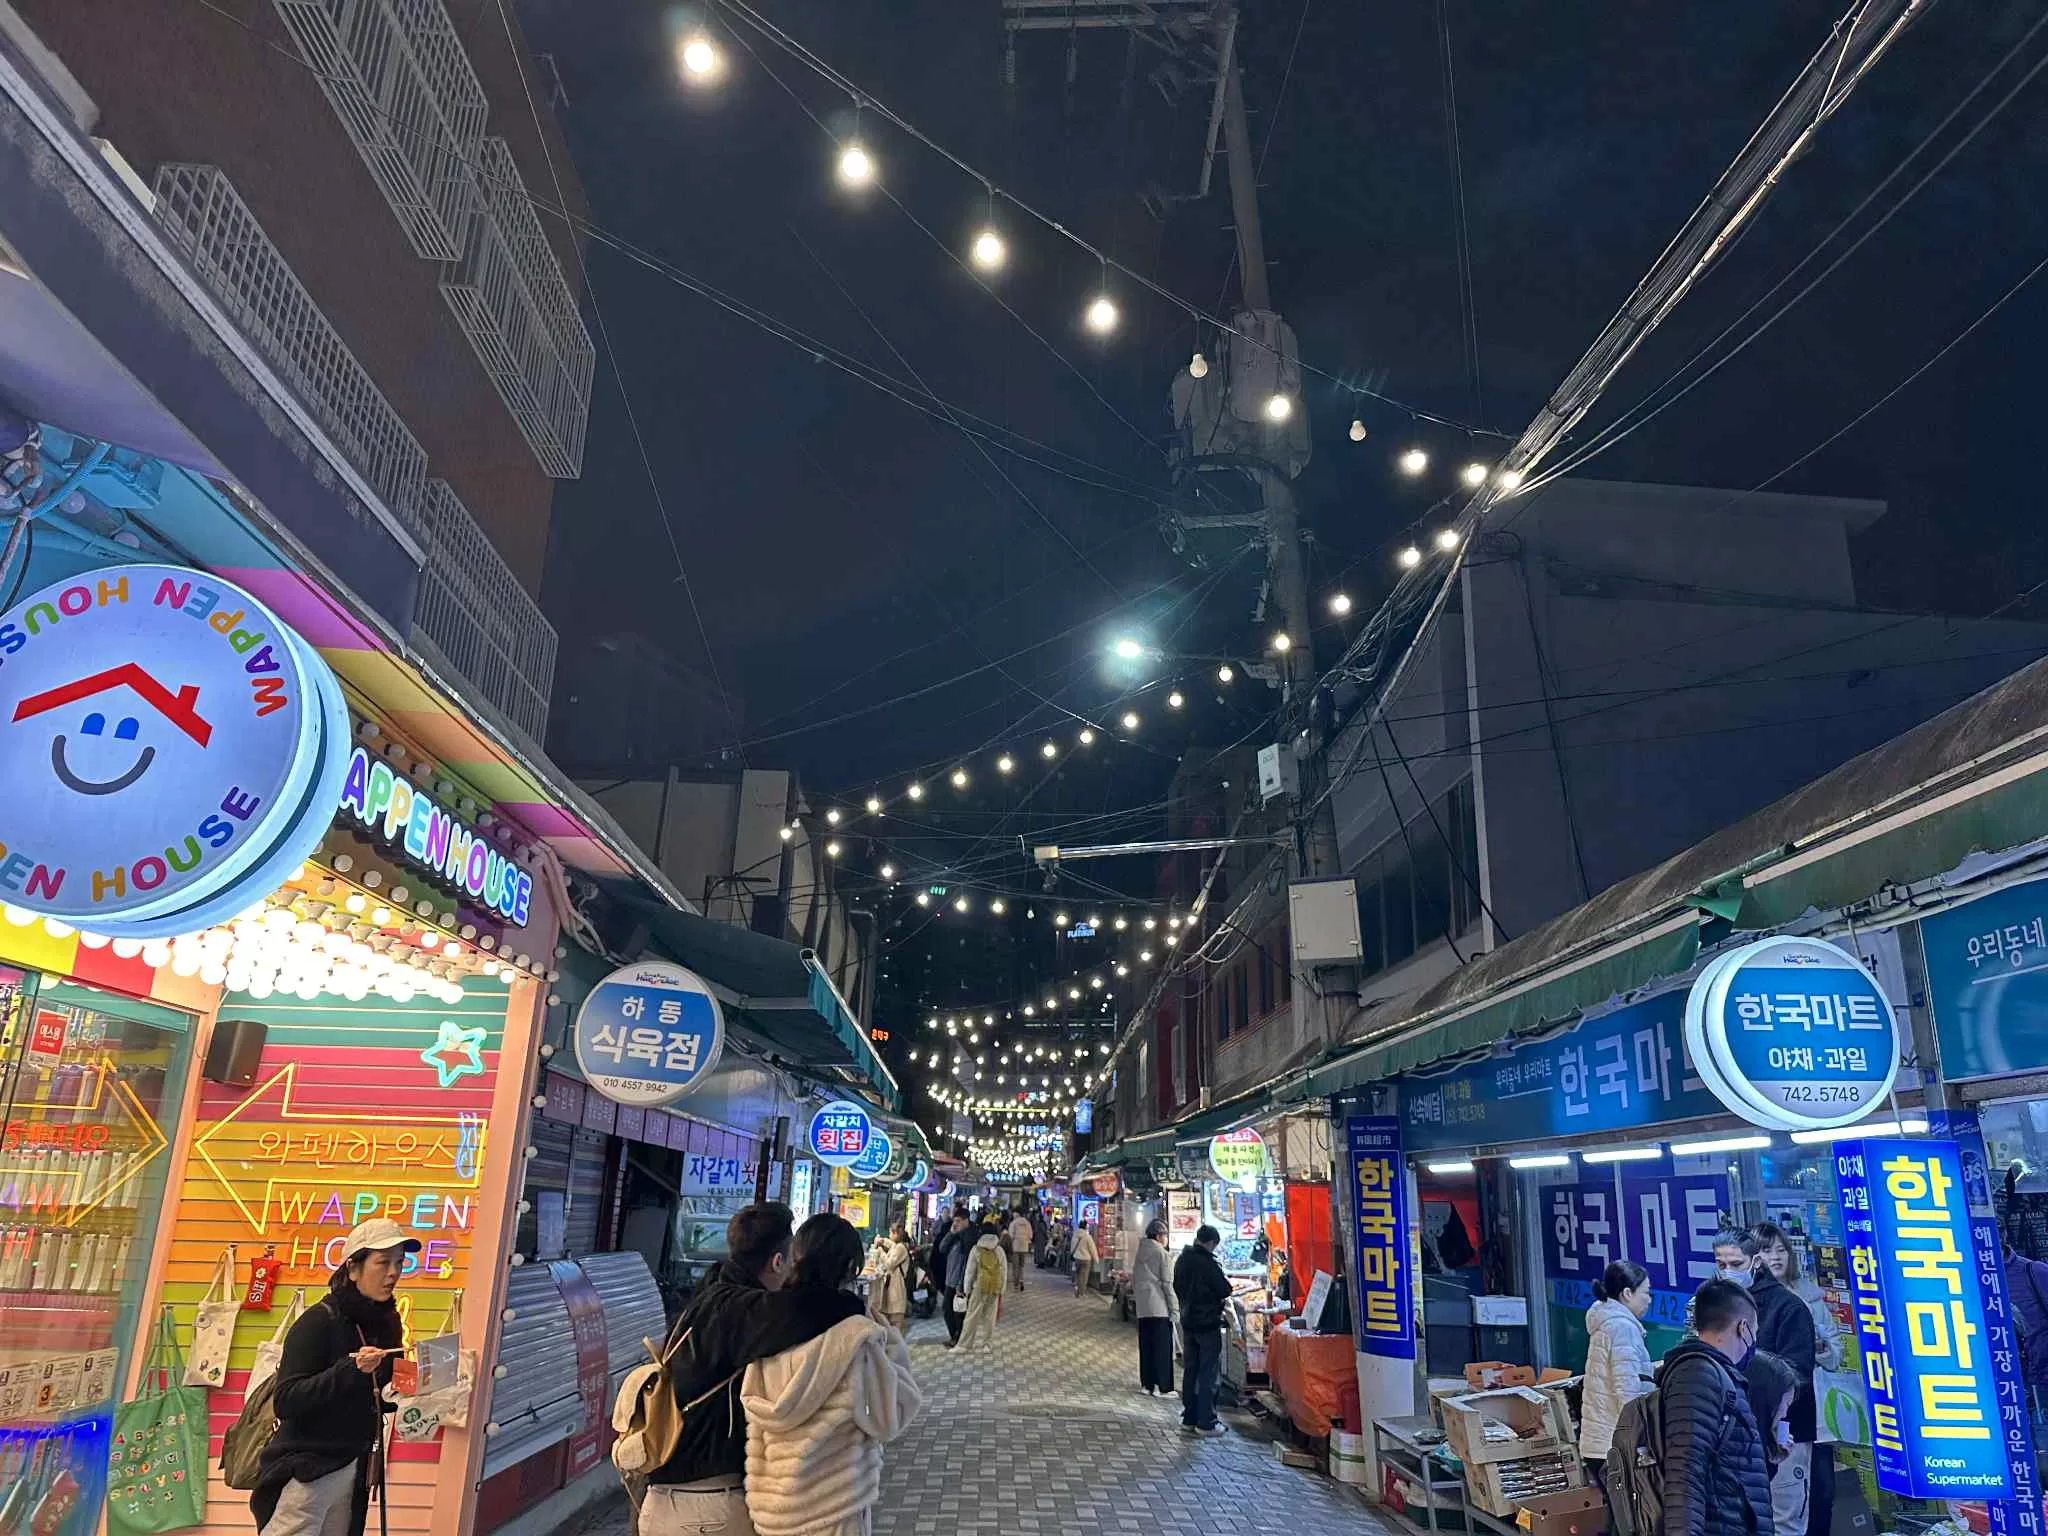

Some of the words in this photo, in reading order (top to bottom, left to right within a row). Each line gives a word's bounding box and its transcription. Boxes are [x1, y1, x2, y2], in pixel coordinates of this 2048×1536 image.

[0, 576, 129, 666] HOUS
[154, 578, 289, 717] WAPPEN
[0, 842, 66, 901] EN
[92, 786, 261, 902] HOUSE
[446, 822, 533, 928] HOUSE
[1966, 917, 2048, 968] 우리동네
[1735, 992, 1883, 1032] 한국마트
[590, 1024, 701, 1072] 식육점
[603, 1077, 619, 1088] 010
[621, 1079, 643, 1090] 4557
[645, 1081, 668, 1094] 9942
[1782, 1086, 1861, 1103] 742.5748
[817, 1128, 863, 1152] 횟집
[822, 1115, 861, 1128] 자갈치
[252, 1130, 457, 1171] 와펜하우스
[689, 1157, 741, 1185] 자갈치
[1838, 1154, 1865, 1179] 야채
[279, 1190, 470, 1228] WAPPEN
[1843, 1187, 1869, 1210] 과일
[1358, 1157, 1401, 1332] 한국마트
[1553, 1182, 1720, 1287] 한국마트
[1974, 1225, 2004, 1318] 해변에서
[1882, 1154, 1991, 1440] 한국마트
[1849, 1244, 1903, 1452] 한국마트
[1990, 1325, 2014, 1373] 가장
[1998, 1380, 2027, 1453] 가까운
[1924, 1455, 1966, 1469] Korean
[1927, 1471, 2003, 1487] Supermarket
